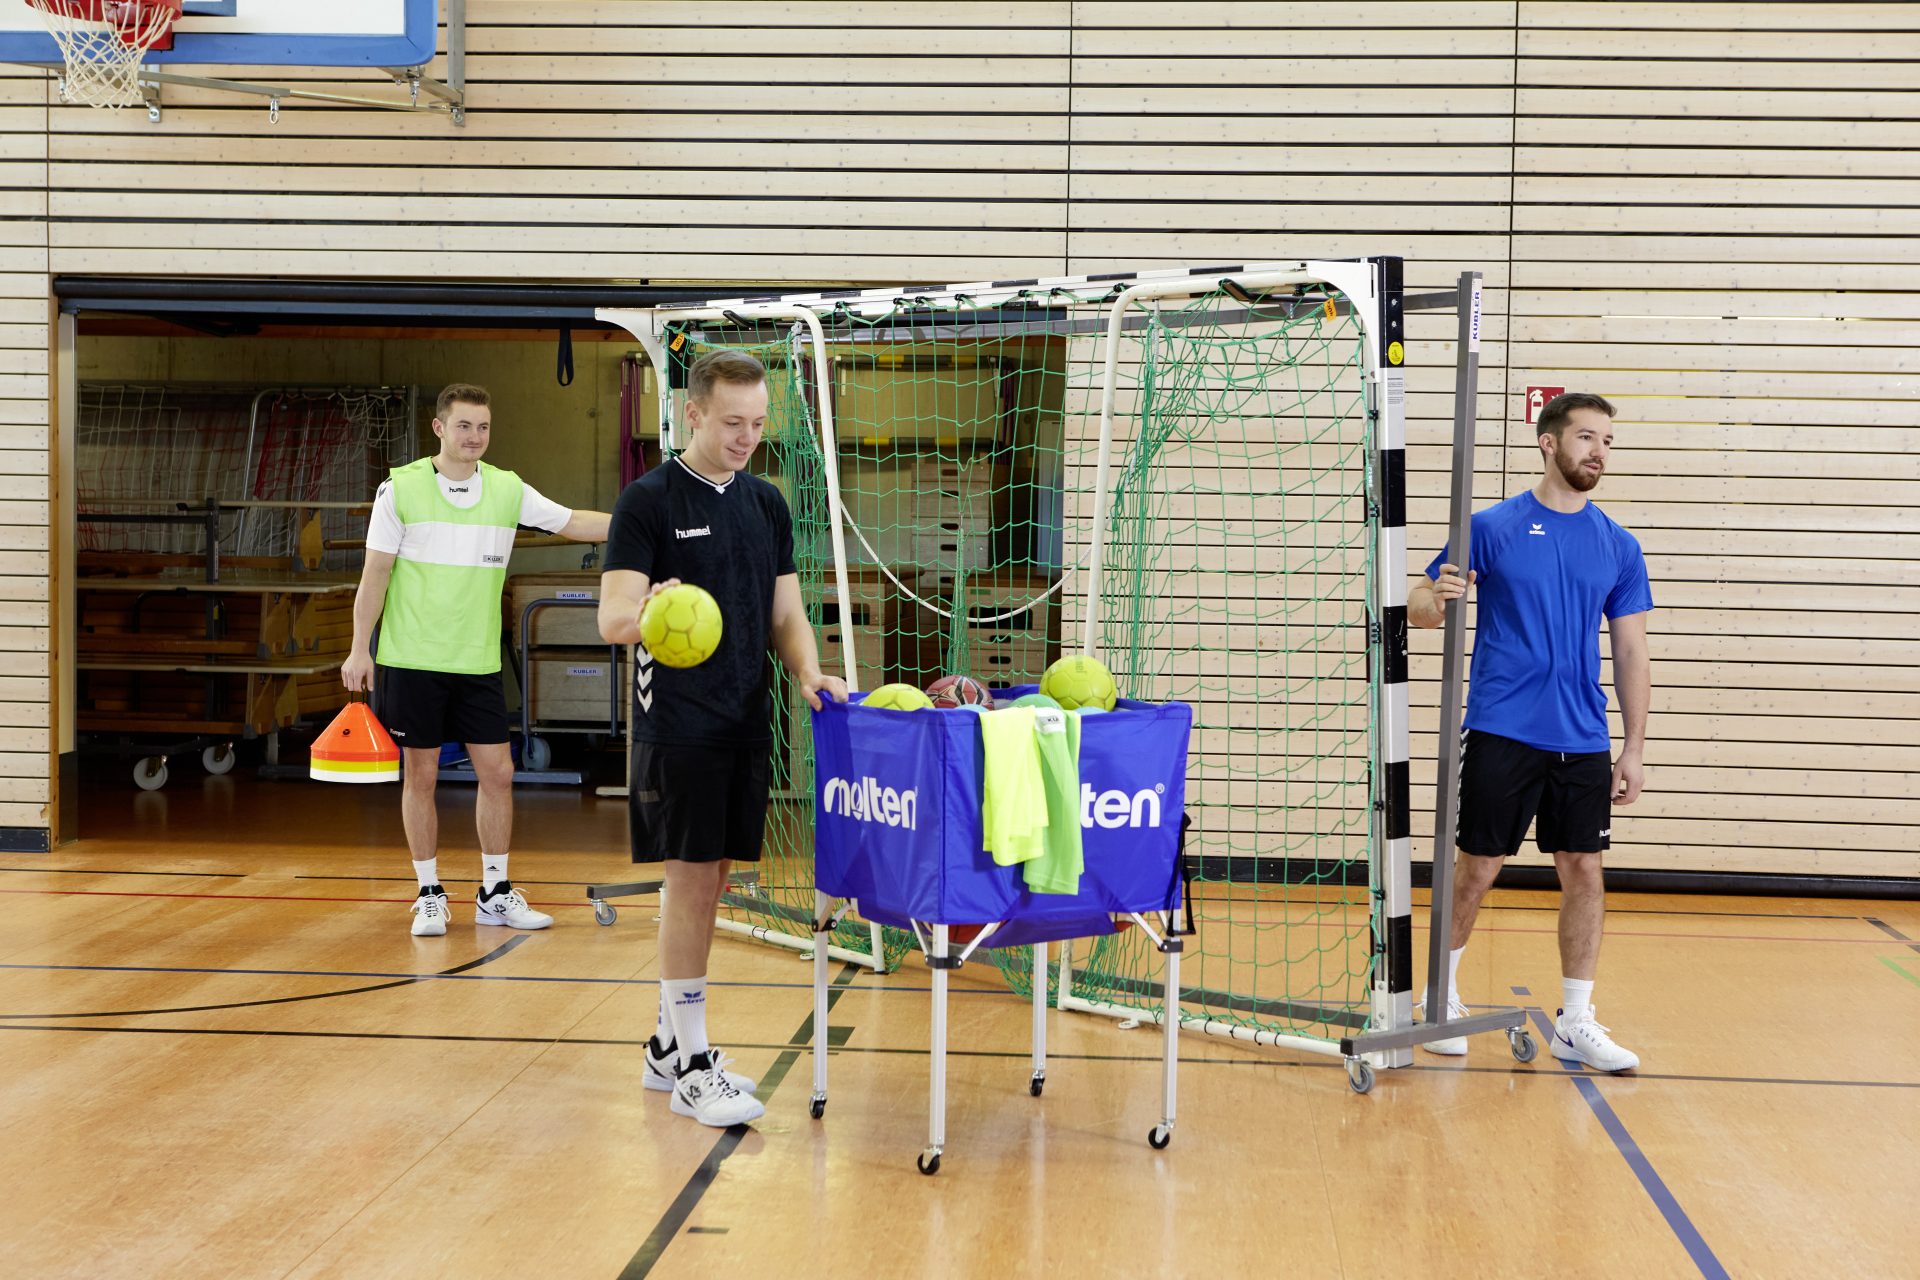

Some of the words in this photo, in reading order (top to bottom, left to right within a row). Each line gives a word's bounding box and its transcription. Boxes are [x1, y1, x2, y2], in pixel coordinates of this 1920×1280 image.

[675, 525, 712, 540] hummel
[824, 776, 918, 831] molten
[1080, 783, 1161, 829] ten
